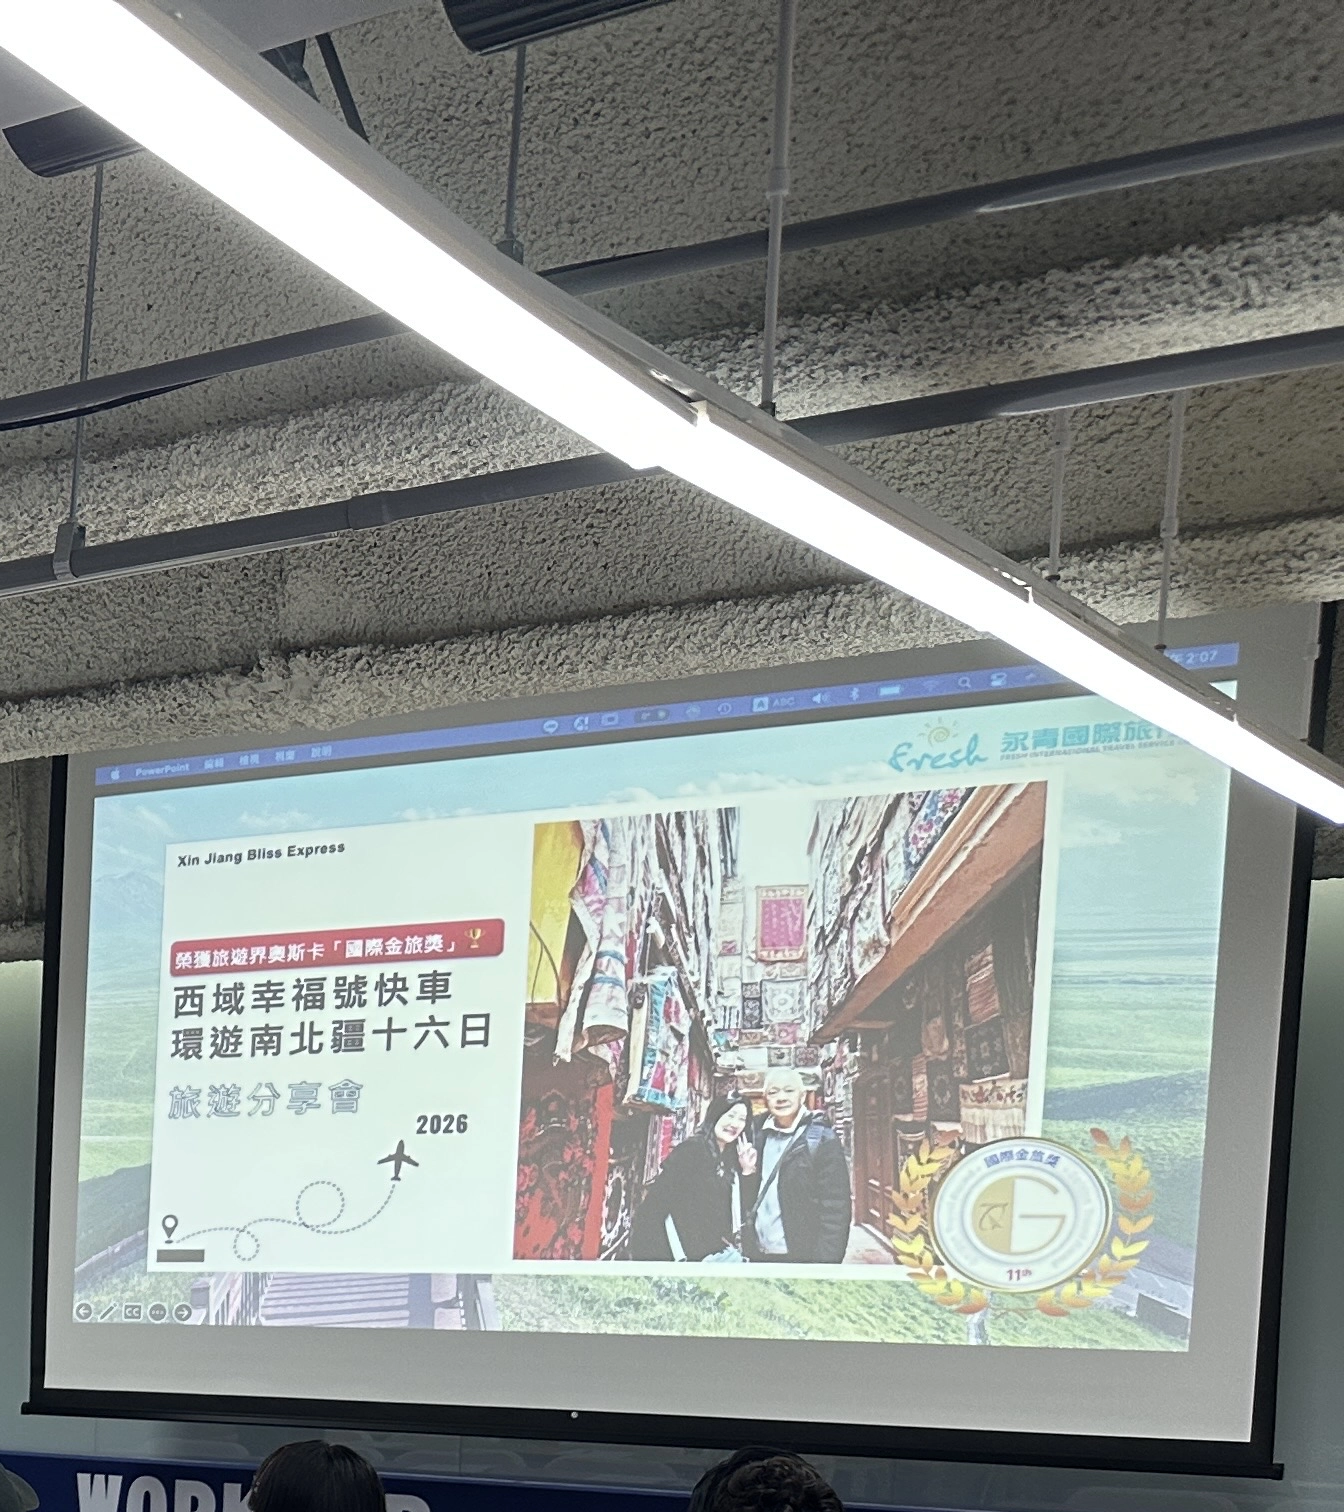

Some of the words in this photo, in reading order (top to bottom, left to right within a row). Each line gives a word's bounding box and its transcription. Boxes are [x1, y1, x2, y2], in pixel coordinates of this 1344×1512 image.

[887, 733, 989, 772] Fresh
[1001, 721, 1164, 752] 永青國際旅
[135, 763, 190, 777] PowerPoint
[177, 855, 200, 867] Xin
[204, 852, 243, 865] Jiang
[247, 848, 283, 861] Bliss
[287, 843, 346, 859] Express
[173, 970, 453, 1019] 西域幸福號快車
[170, 1012, 491, 1061] 環遊南北疆十六日
[167, 1078, 364, 1120] 旅遊分享會
[415, 1113, 468, 1135] 2026
